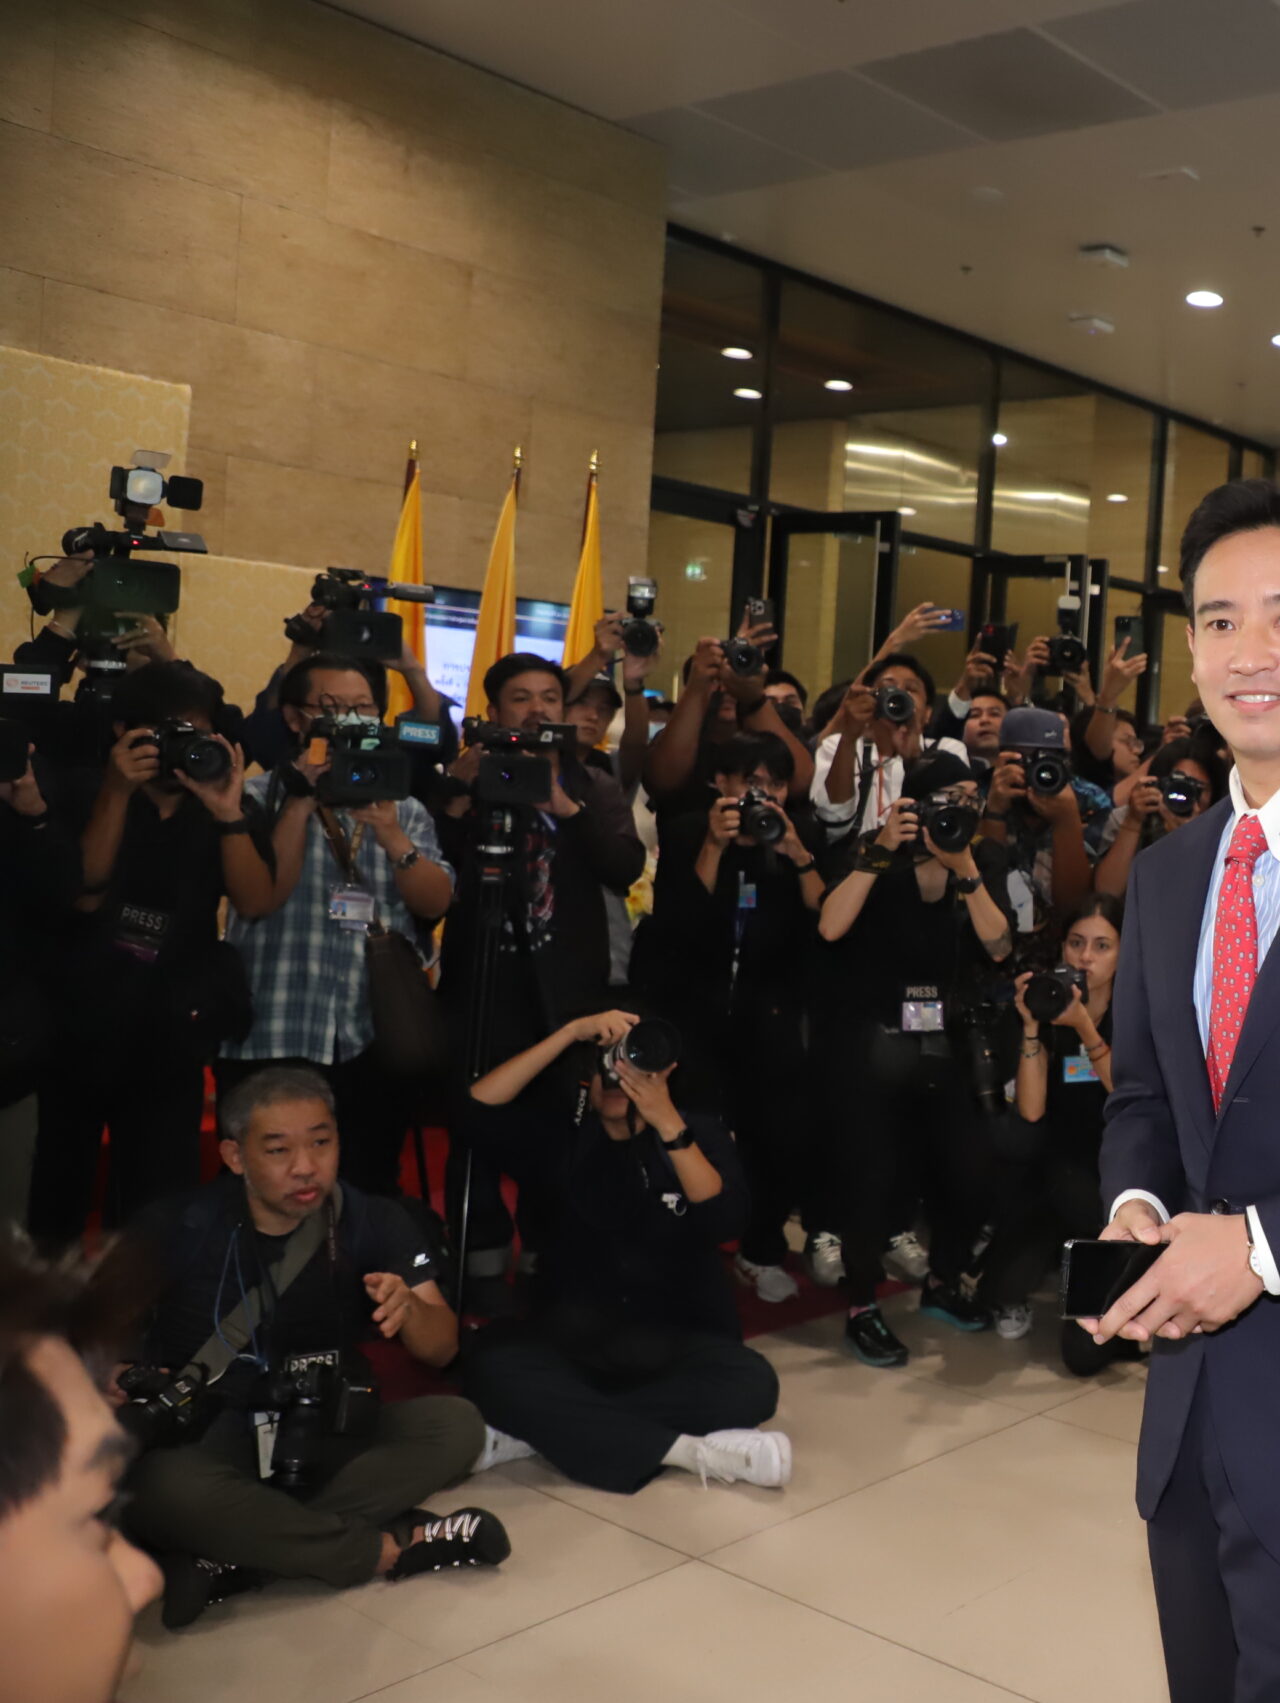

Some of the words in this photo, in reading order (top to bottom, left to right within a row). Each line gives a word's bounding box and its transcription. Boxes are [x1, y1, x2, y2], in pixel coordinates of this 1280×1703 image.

[403, 725, 437, 739] PRESS
[121, 905, 163, 931] PRESS
[906, 986, 938, 998] PRESS
